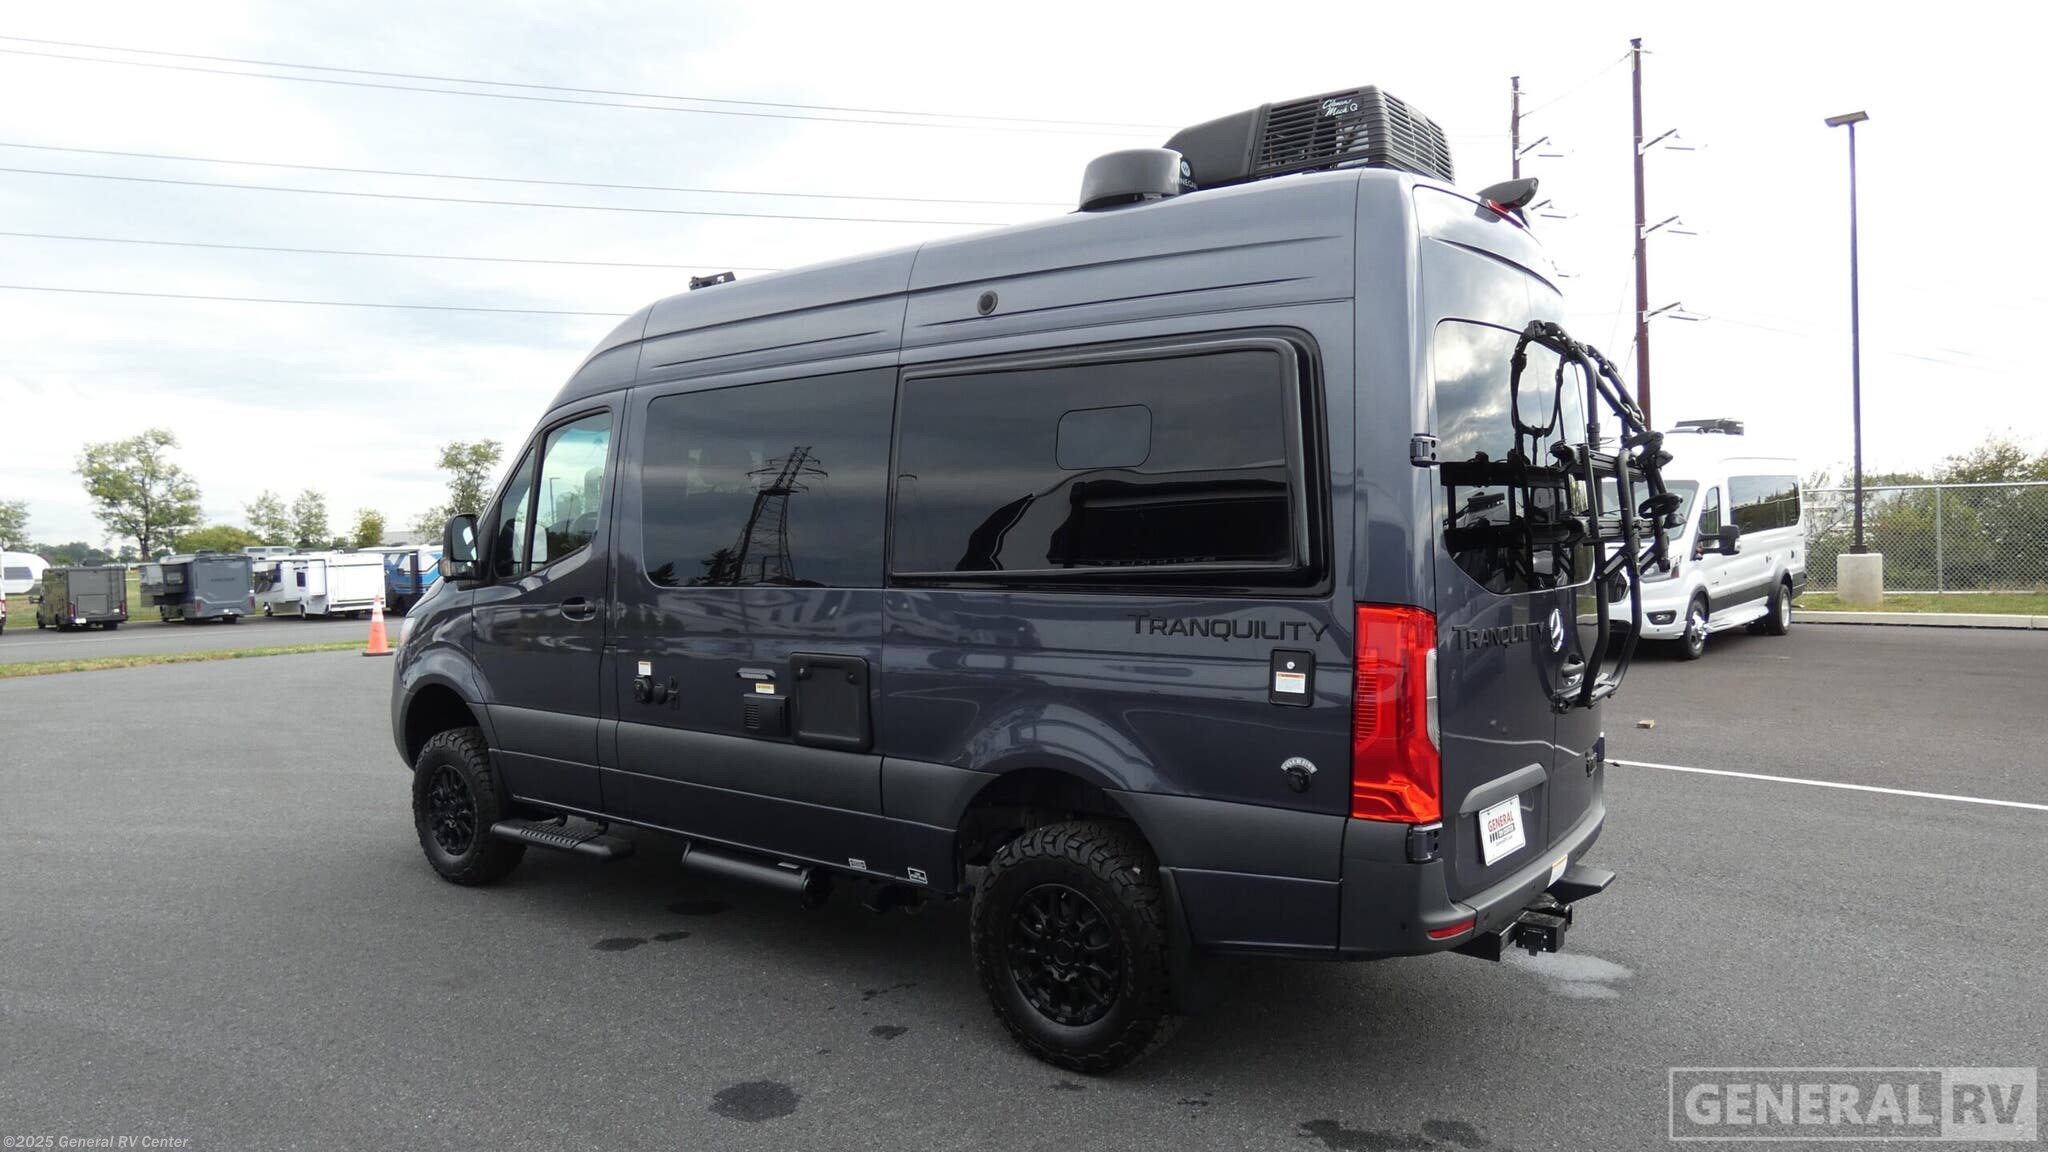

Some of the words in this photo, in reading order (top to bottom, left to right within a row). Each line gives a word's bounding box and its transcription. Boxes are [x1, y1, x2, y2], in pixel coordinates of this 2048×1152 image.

[1127, 610, 1330, 642] TRANQUILITY
[1452, 622, 1545, 651] TRANQUILITY
[1488, 811, 1514, 833] GENERAL
